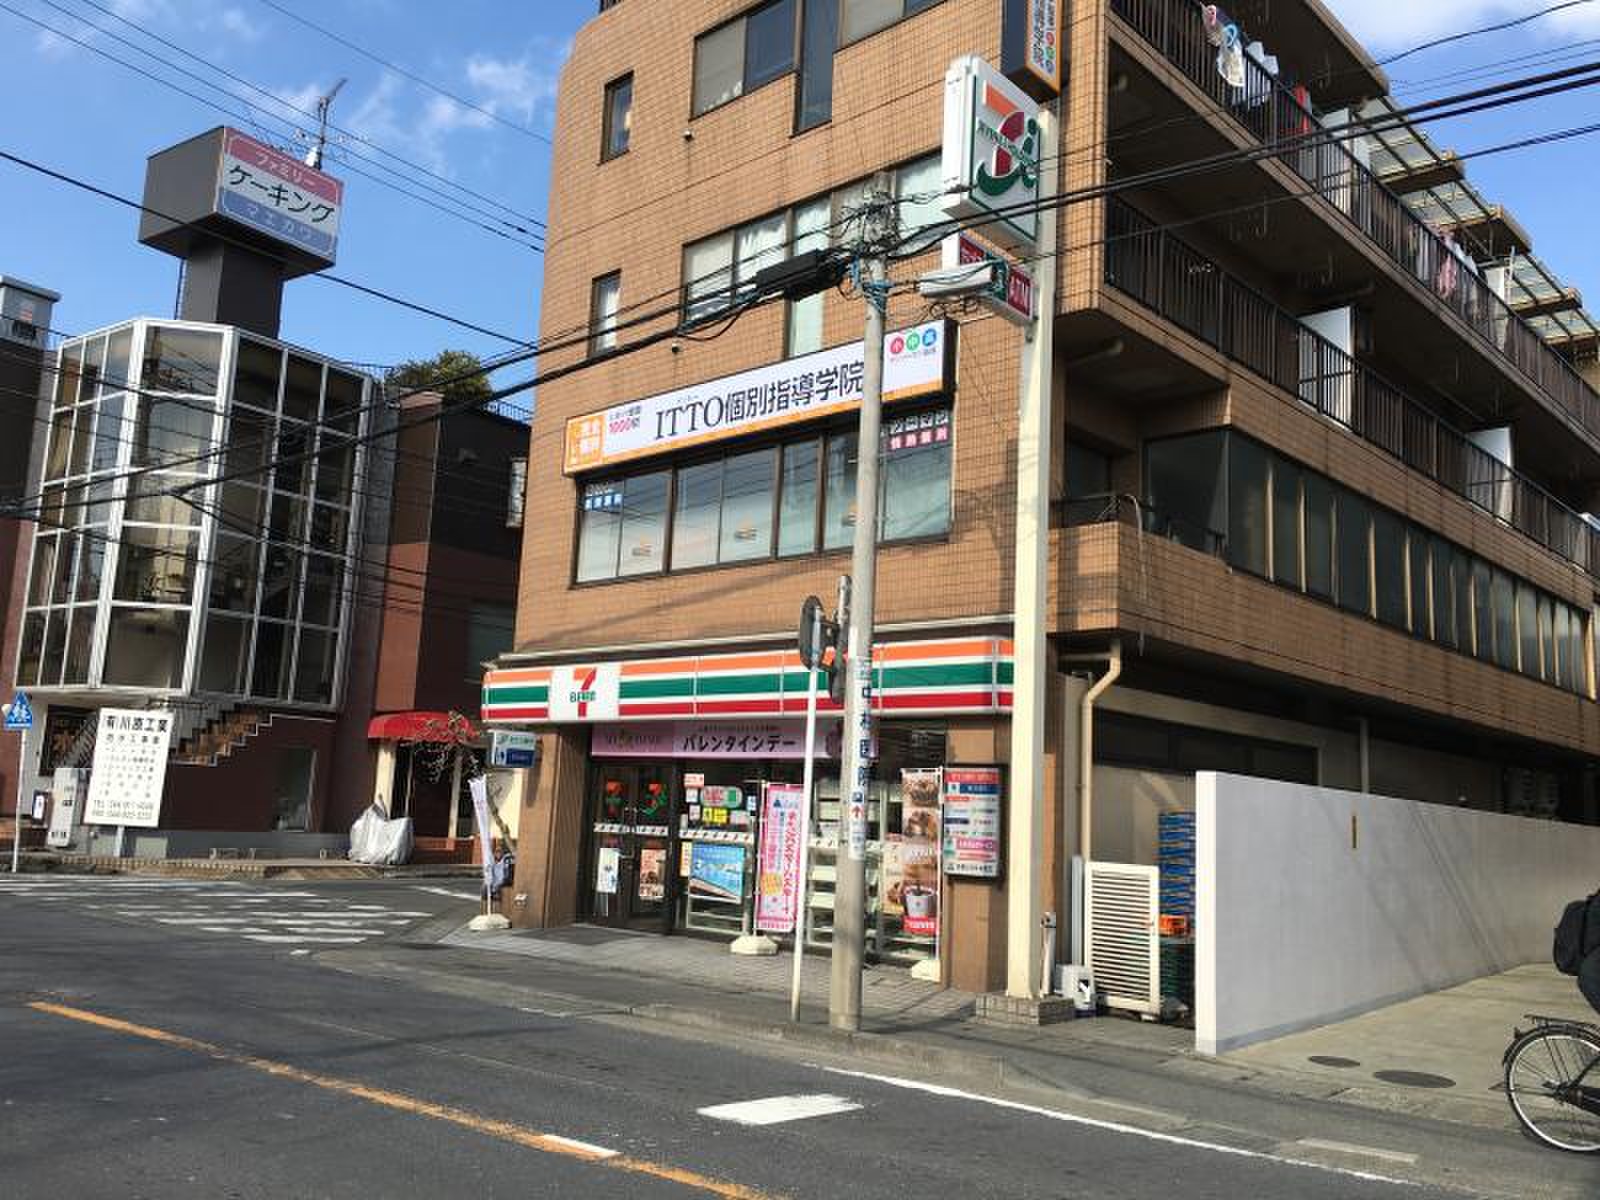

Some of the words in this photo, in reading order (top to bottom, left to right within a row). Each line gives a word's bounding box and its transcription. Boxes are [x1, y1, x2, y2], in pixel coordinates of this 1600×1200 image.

[229, 164, 335, 222] ケーキング
[654, 359, 864, 440] ITTO個別指導学院
[683, 733, 796, 752] バレンタインデー
